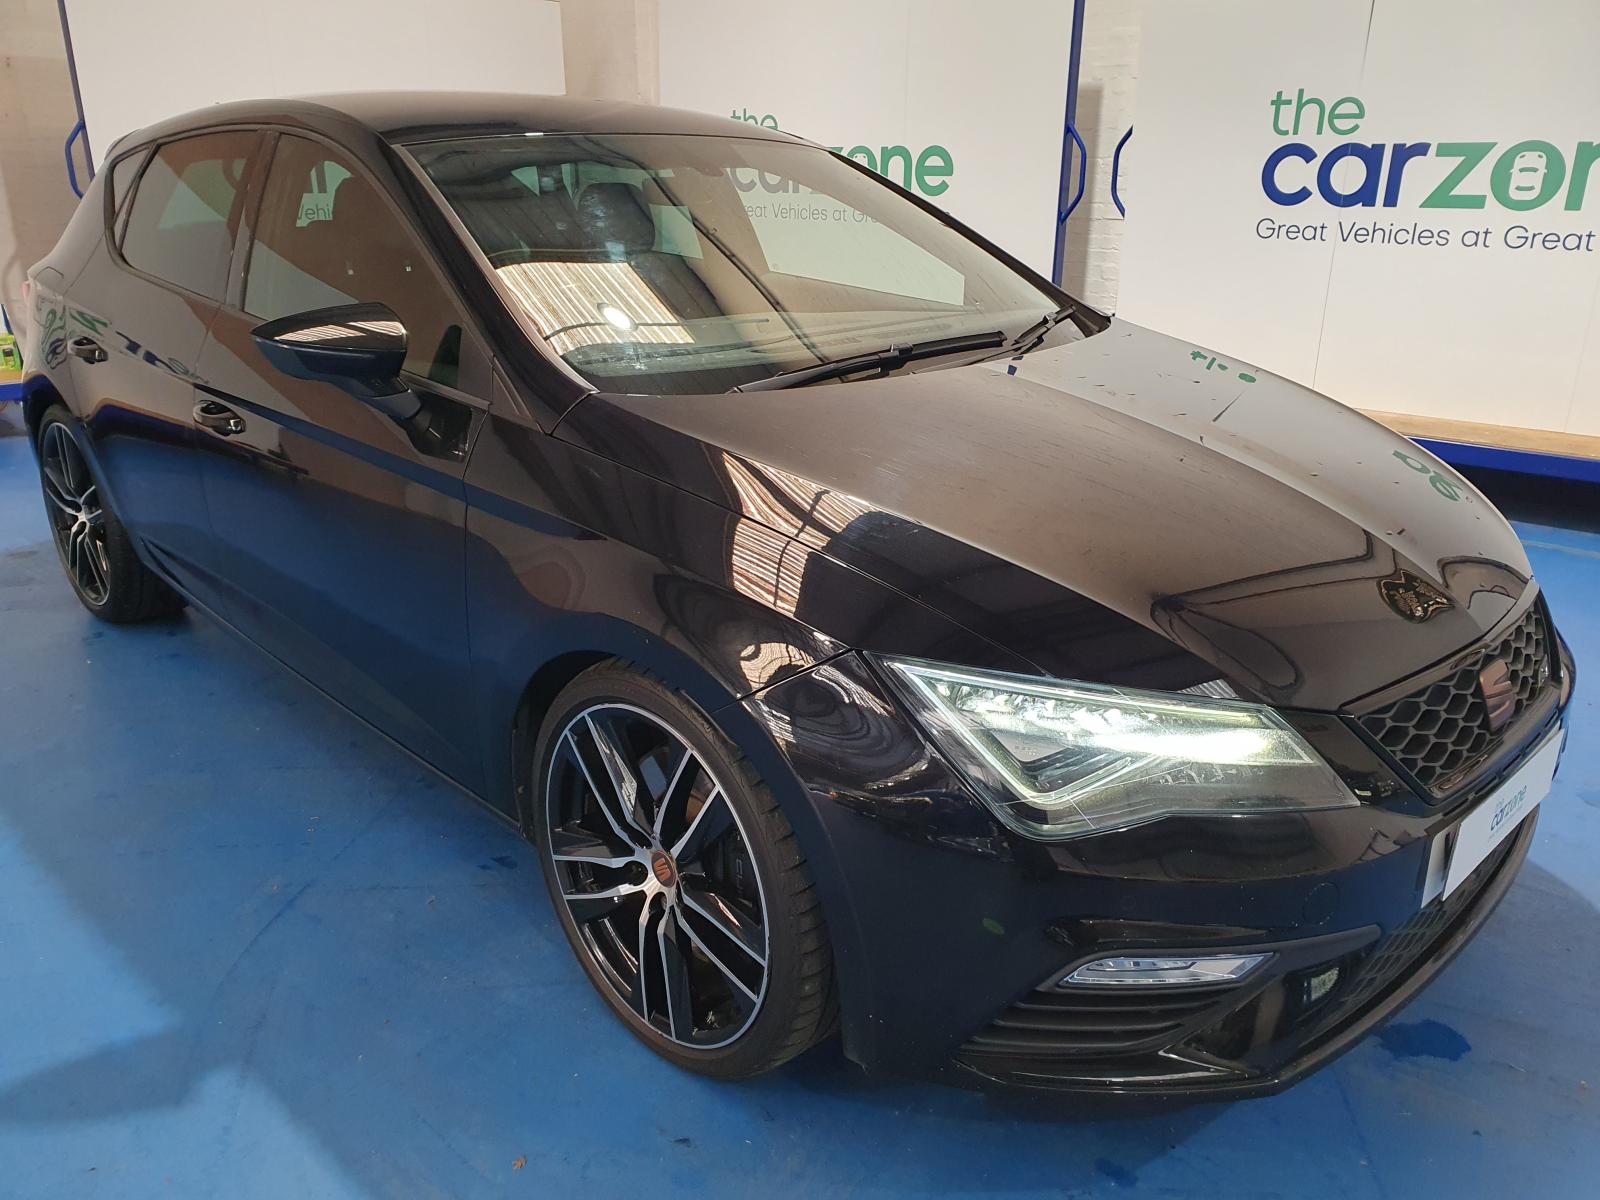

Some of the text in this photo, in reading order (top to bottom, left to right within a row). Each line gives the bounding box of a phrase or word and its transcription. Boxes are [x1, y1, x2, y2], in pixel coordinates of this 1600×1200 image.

[1270, 88, 1365, 136] the
[772, 202, 828, 222] Vehicles
[833, 207, 848, 222] at
[1256, 217, 1597, 252] Great Vehicles at Great
